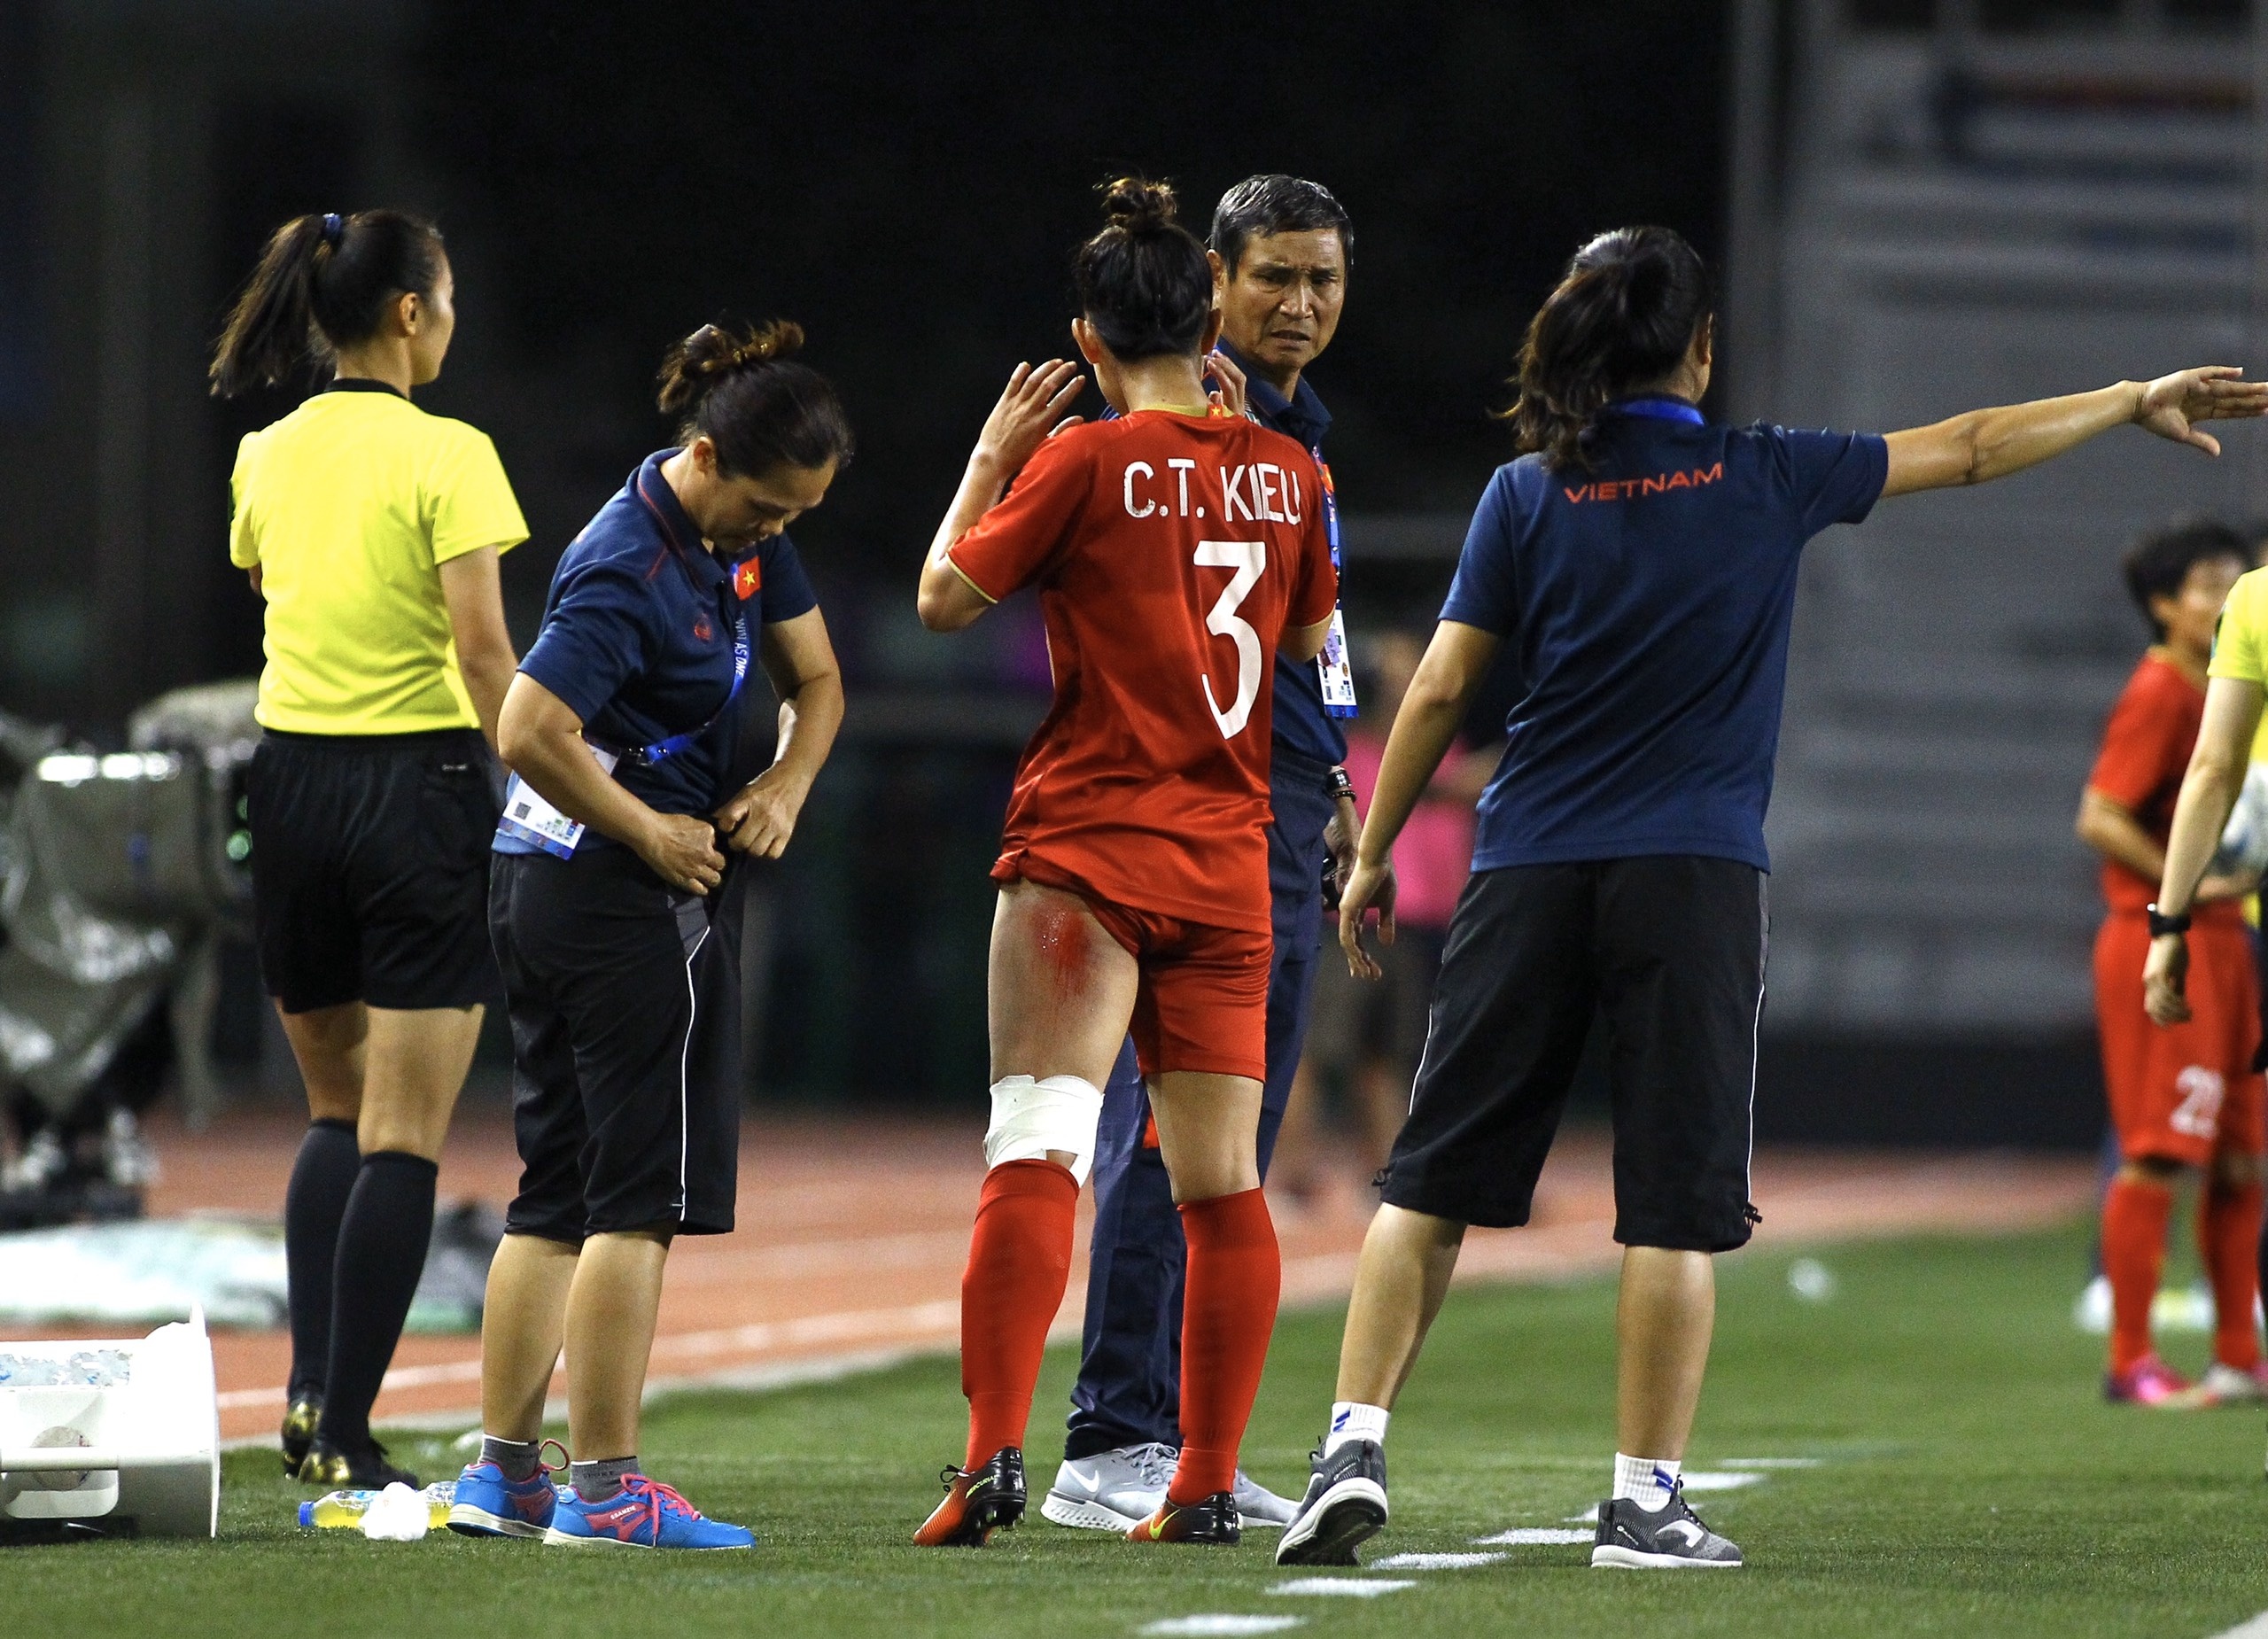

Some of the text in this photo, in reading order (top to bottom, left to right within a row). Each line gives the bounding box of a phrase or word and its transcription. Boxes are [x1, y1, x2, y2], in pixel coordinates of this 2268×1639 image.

[1123, 458, 1301, 525] C.T. KIEU
[1564, 462, 1723, 504] VIETNAM
[734, 618, 748, 679] WIN AS ONE
[1193, 540, 1266, 740] 3
